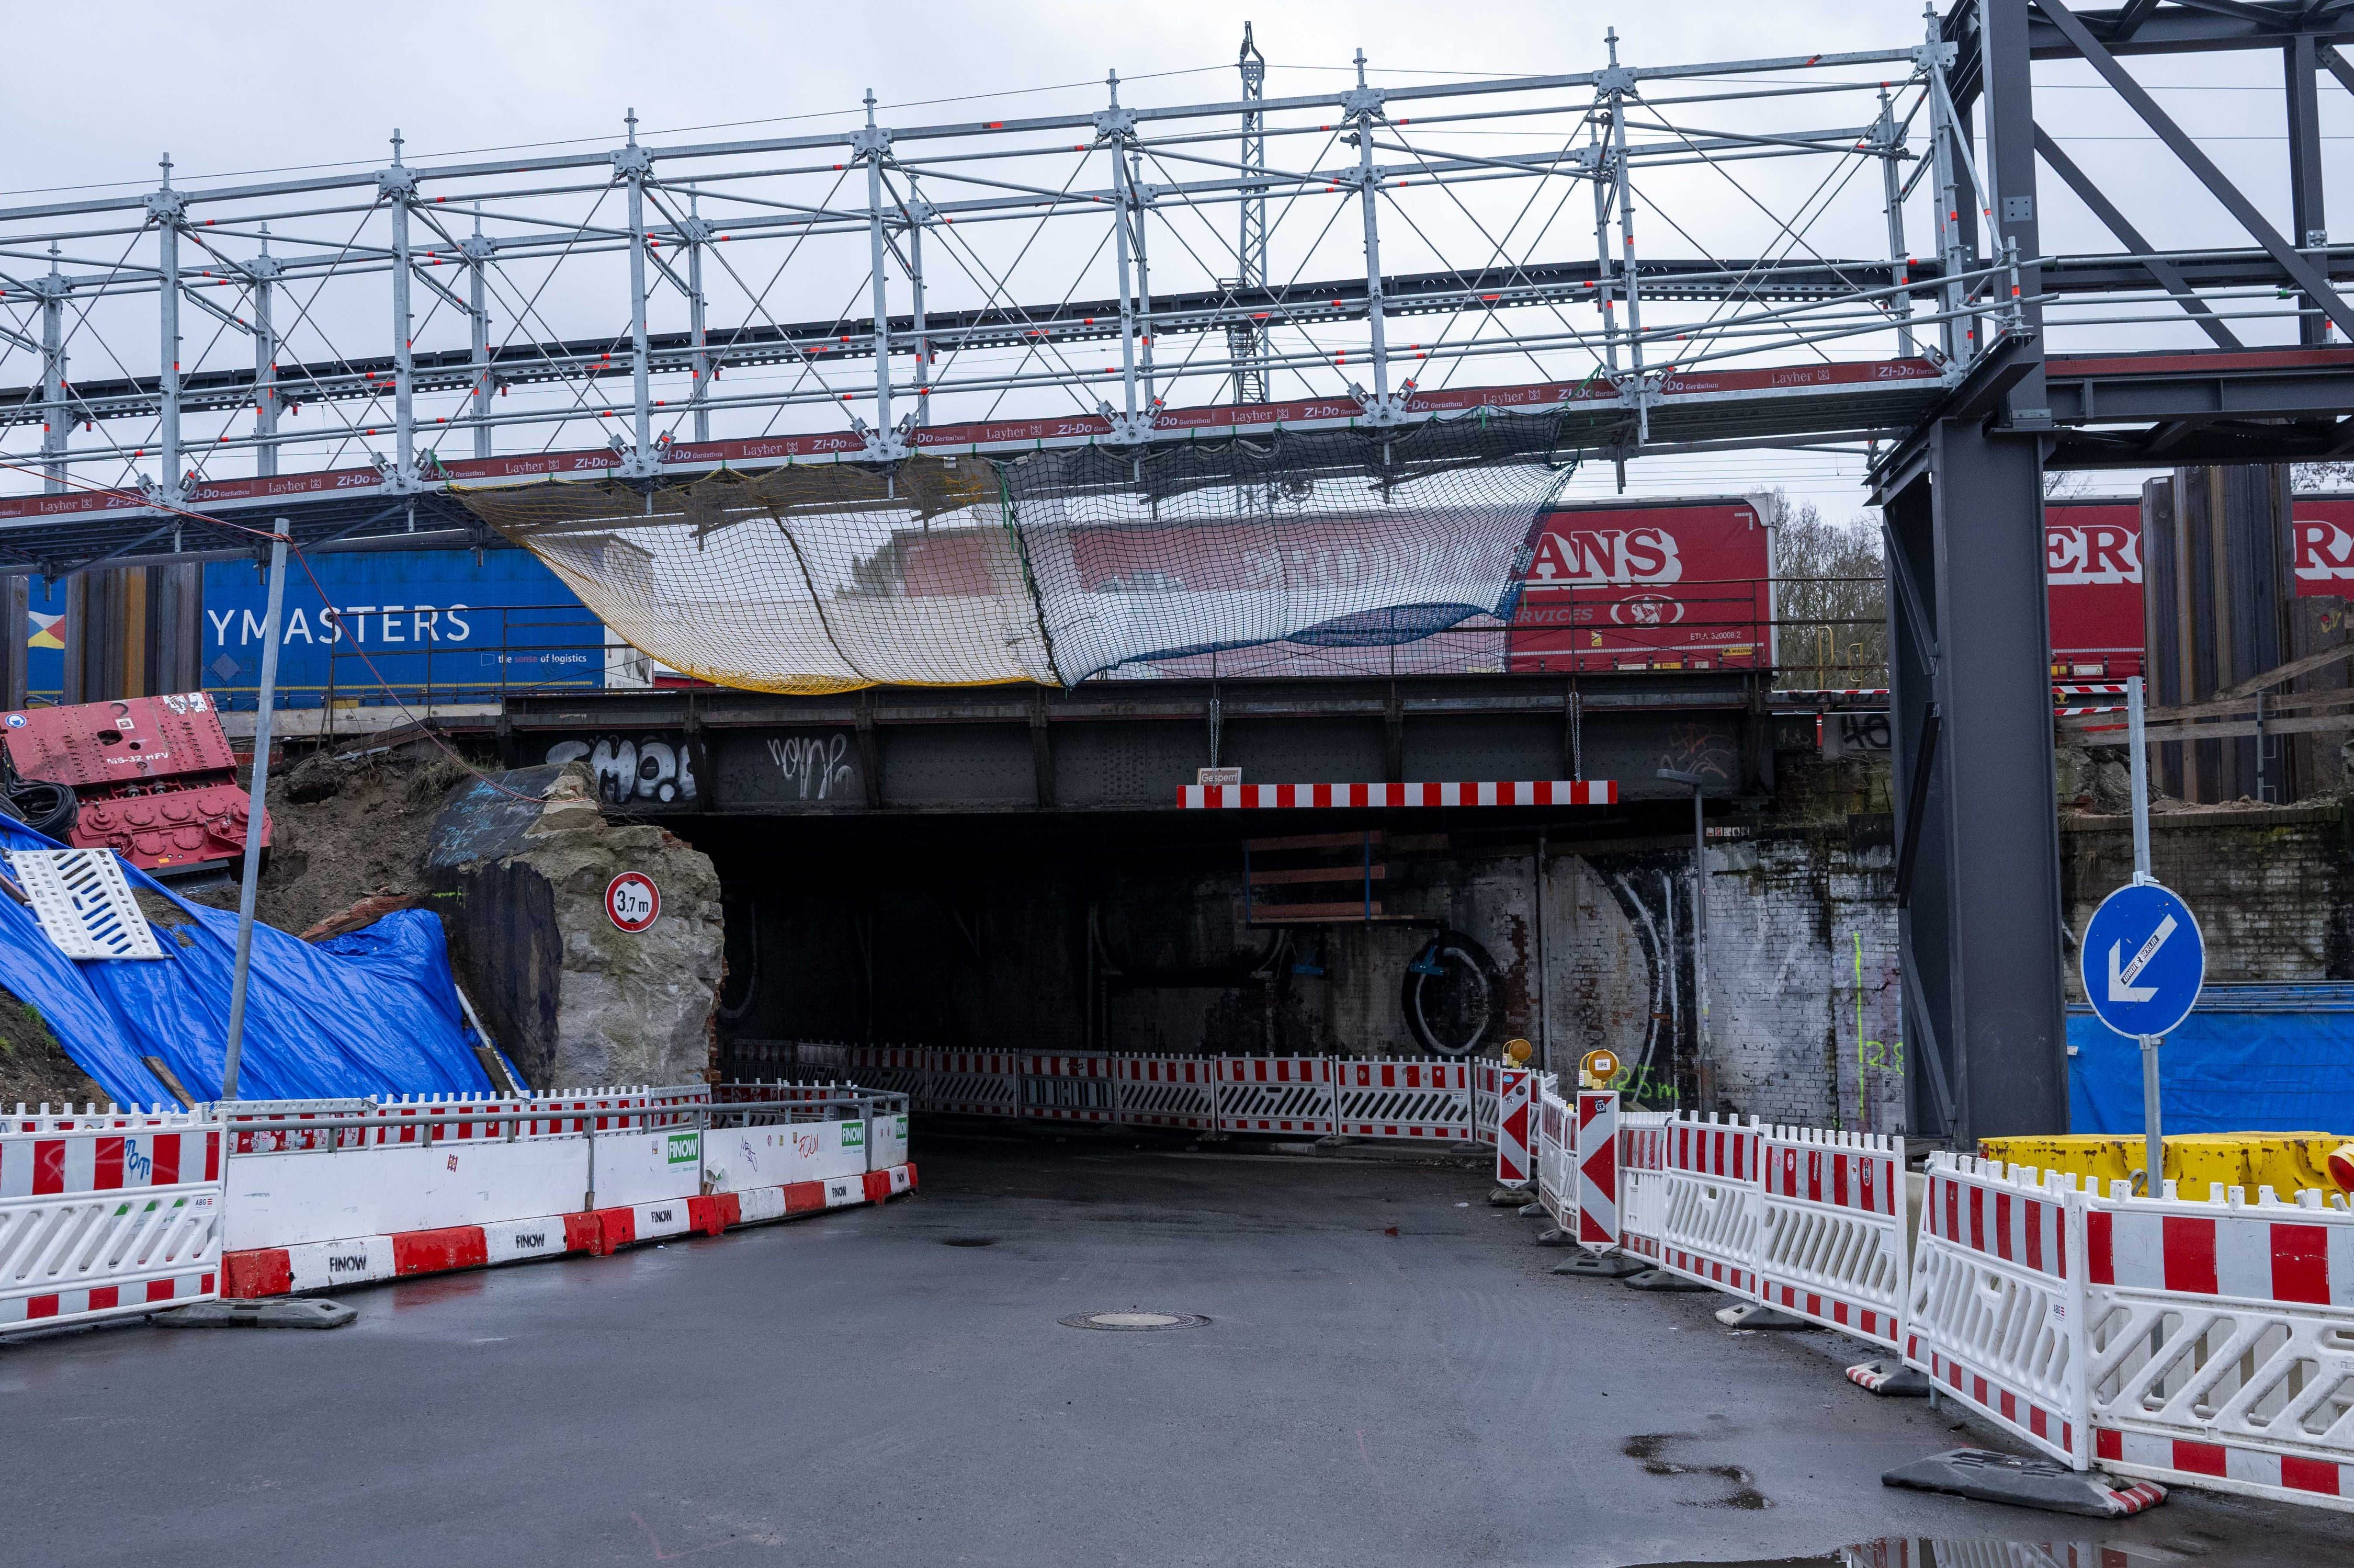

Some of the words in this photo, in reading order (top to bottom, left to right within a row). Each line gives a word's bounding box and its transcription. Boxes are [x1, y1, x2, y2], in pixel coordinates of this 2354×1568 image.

[1878, 366, 1915, 377] Zi-Do
[1772, 373, 1813, 385] Layher
[1685, 382, 1718, 391] Gerüstbau
[1483, 392, 1524, 405] Layher
[1231, 411, 1272, 423] Layher
[1304, 407, 1339, 418] Zi-Do
[987, 427, 1026, 440] Layher
[1058, 423, 1092, 434] Zi-Do
[743, 443, 782, 456] Layher
[812, 439, 847, 450] Zi-Do
[505, 462, 544, 474] Layher
[574, 457, 608, 469] Zi-Do
[337, 475, 369, 486] Zi-Do
[268, 481, 306, 494] Layher
[40, 501, 77, 513] Layher
[208, 604, 470, 646] YMASTERS
[499, 654, 511, 663] the
[540, 654, 549, 663] of
[552, 654, 586, 664] logistics
[617, 890, 636, 913] 3,7
[639, 901, 649, 912] m
[896, 1121, 907, 1135] FINOW
[842, 1127, 863, 1142] FINOW
[669, 1139, 697, 1158] FINOW
[832, 1186, 846, 1198] FINOW
[651, 1209, 672, 1223] FINOW
[515, 1233, 545, 1248] FINOW
[330, 1255, 367, 1272] FINOW
